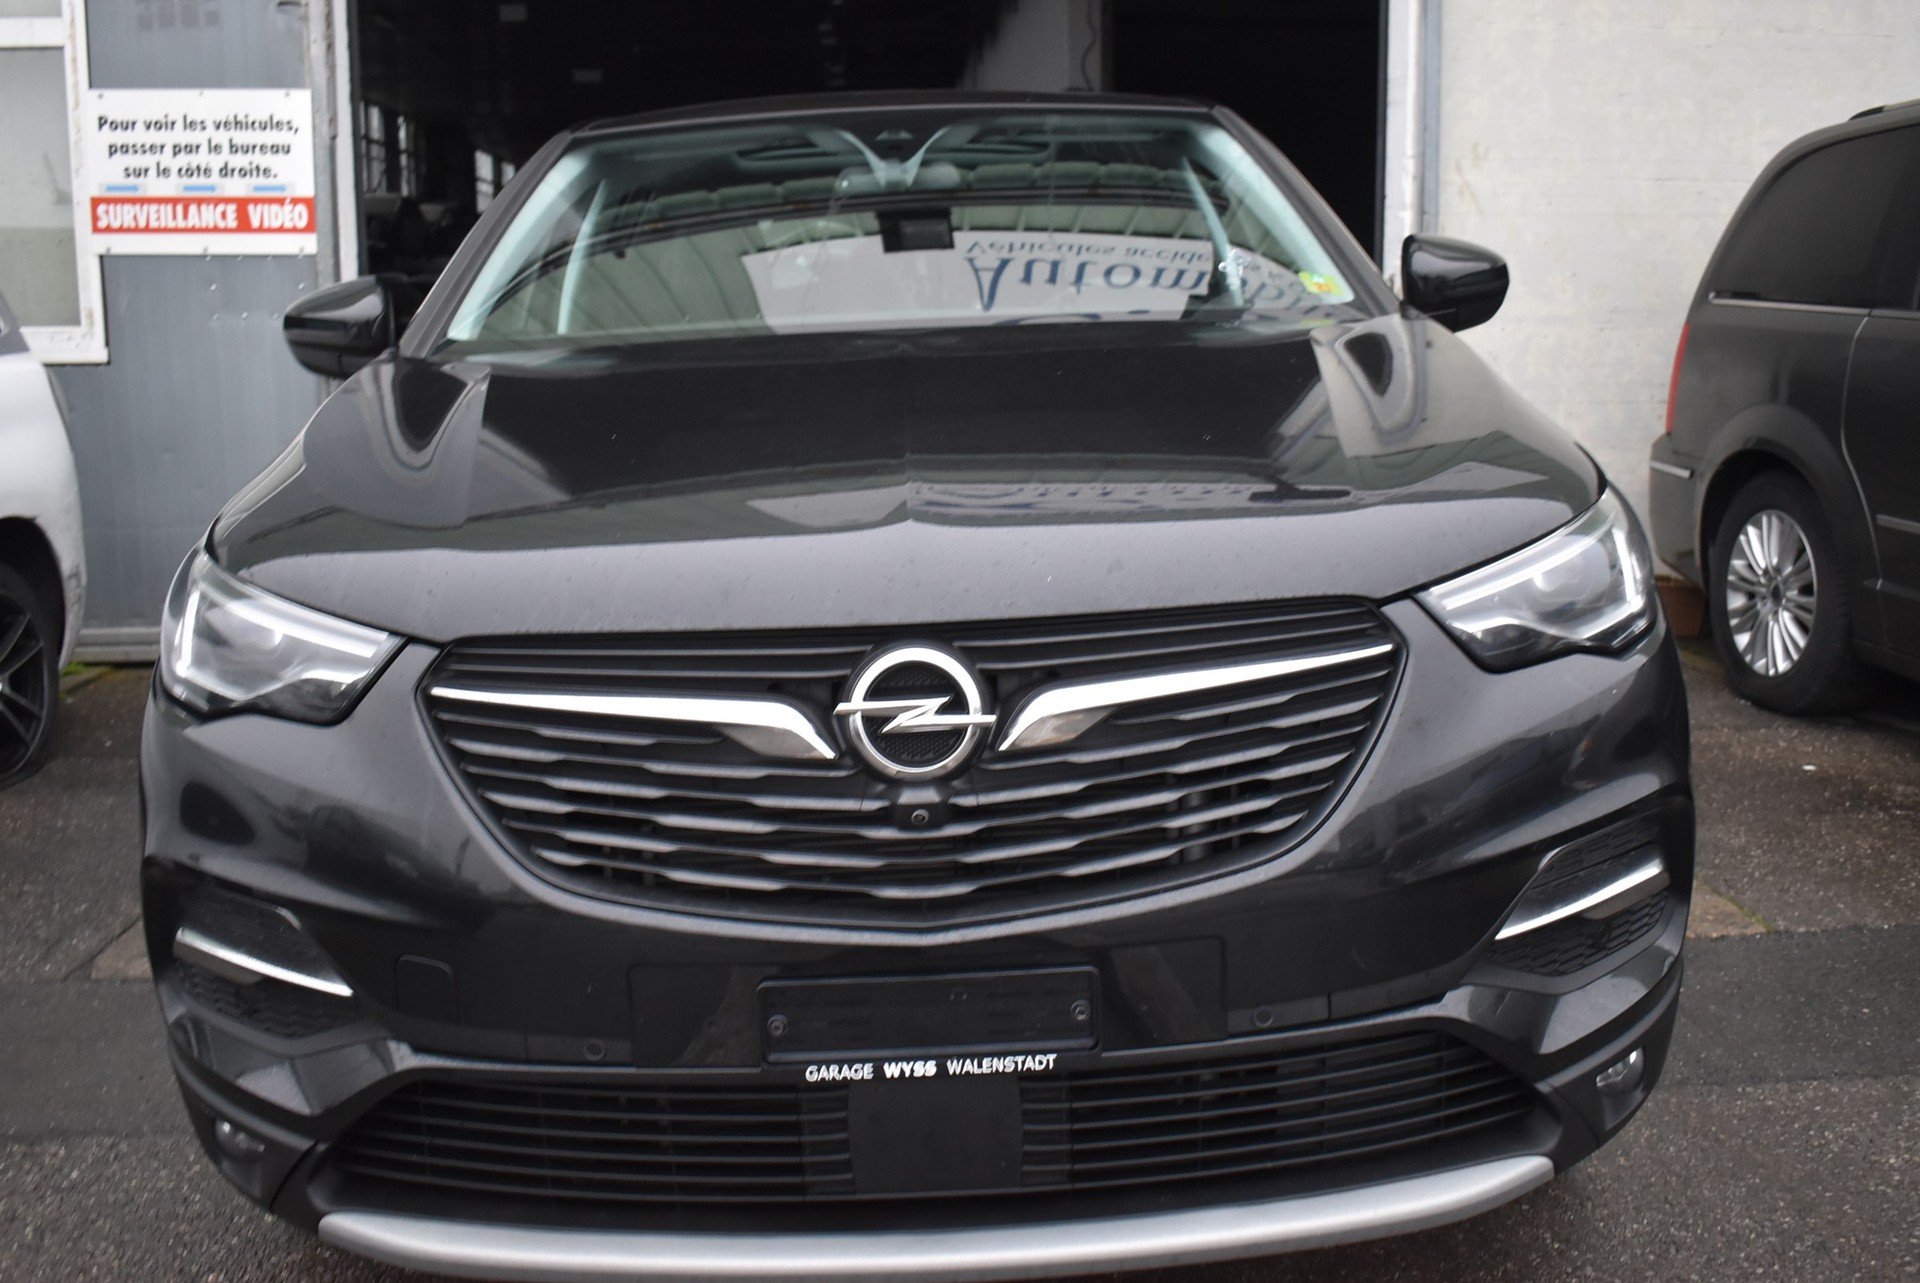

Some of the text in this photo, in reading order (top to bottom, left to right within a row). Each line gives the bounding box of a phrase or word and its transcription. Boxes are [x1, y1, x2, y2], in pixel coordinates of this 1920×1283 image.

[98, 114, 299, 135] Pour voir les véhicules,
[108, 138, 291, 159] passer par le bureau
[123, 166, 150, 179] sur
[156, 162, 171, 179] le
[219, 163, 278, 179] droite.
[97, 198, 309, 229] SURVEILLANCE VIDÉO
[805, 1053, 1057, 1082] GARAGE WYSS WALENSTADT
